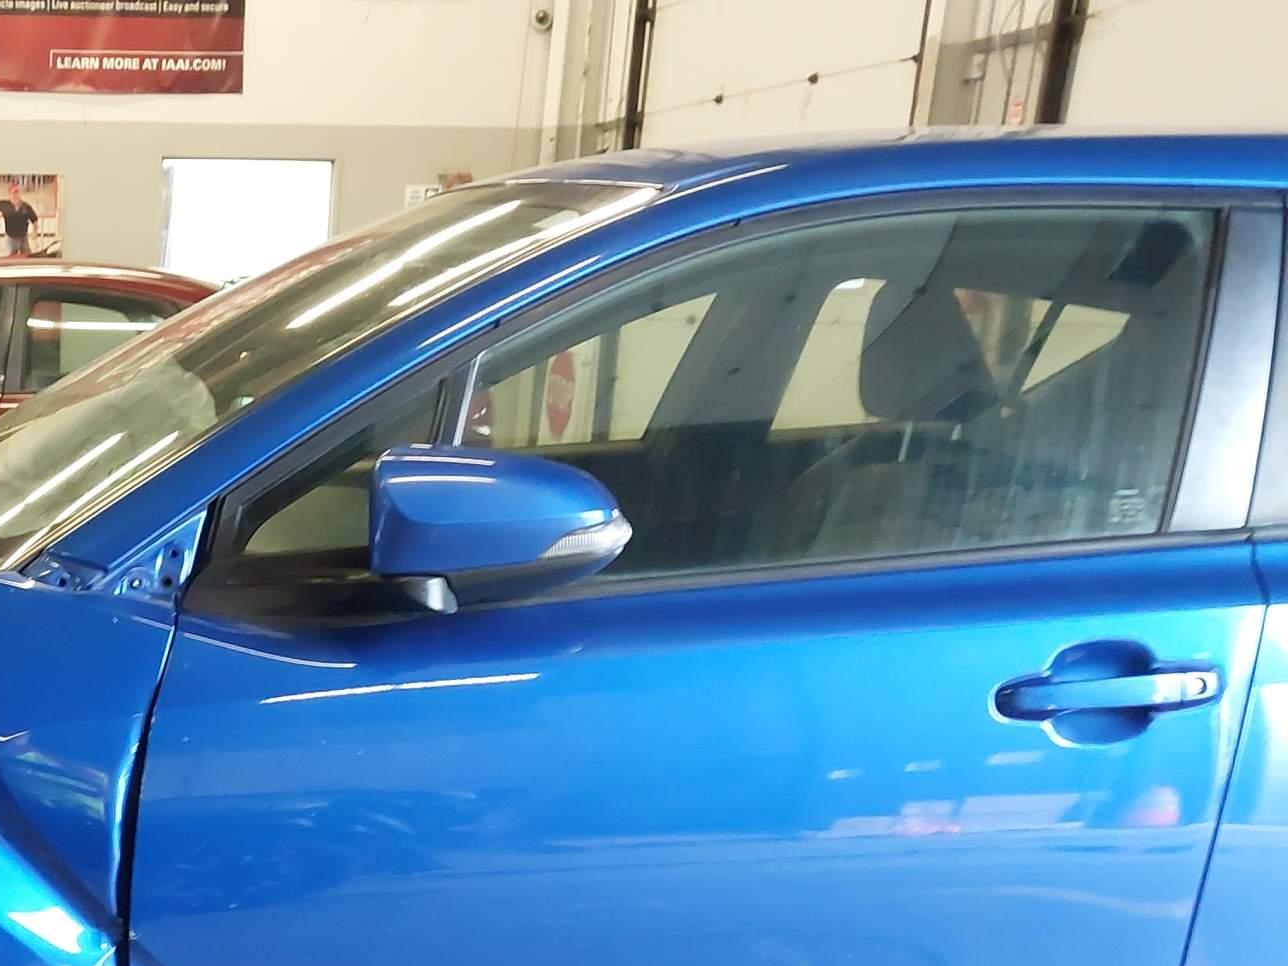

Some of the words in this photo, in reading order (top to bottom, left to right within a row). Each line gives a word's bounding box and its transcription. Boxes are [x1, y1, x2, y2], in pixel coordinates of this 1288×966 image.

[15, 1, 45, 12] images
[52, 1, 67, 10] Live
[70, 2, 113, 10] auctioneer
[116, 2, 157, 11] broadcast
[163, 2, 182, 13] Easy
[184, 3, 199, 12] and
[201, 4, 229, 12] secure
[57, 56, 100, 70] LEARN
[103, 57, 140, 70] MORE
[142, 58, 159, 70] AT
[162, 58, 227, 71] IAAI.COM!
